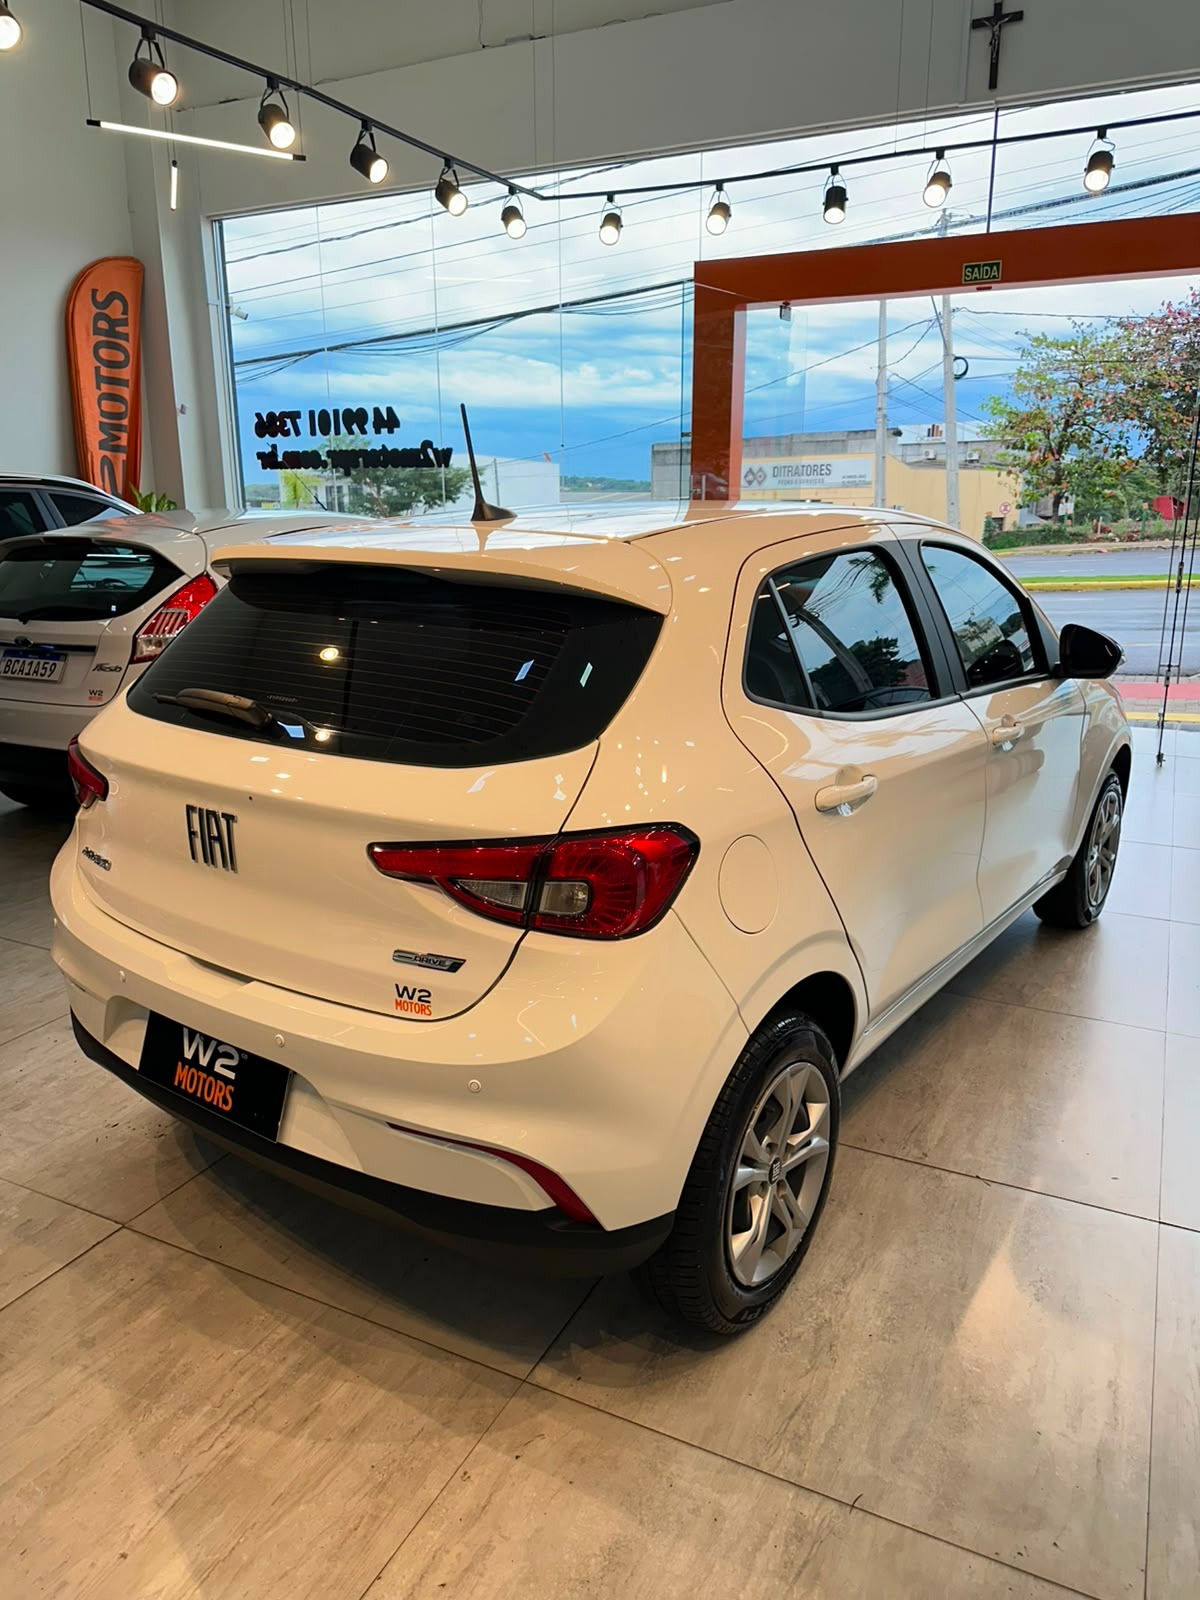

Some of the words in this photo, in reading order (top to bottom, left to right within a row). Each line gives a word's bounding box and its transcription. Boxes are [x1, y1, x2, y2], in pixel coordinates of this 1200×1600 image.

[965, 263, 999, 281] SAÍDA
[91, 288, 131, 454] MOTORS
[772, 463, 832, 478] DITRATORES
[3, 659, 57, 678] BCA1A59
[185, 803, 238, 874] FIAT
[413, 955, 450, 968] DRIVE
[394, 983, 432, 1004] W2
[394, 998, 432, 1017] MOTORS
[182, 1026, 240, 1080] W2
[173, 1060, 235, 1112] MOTORS
